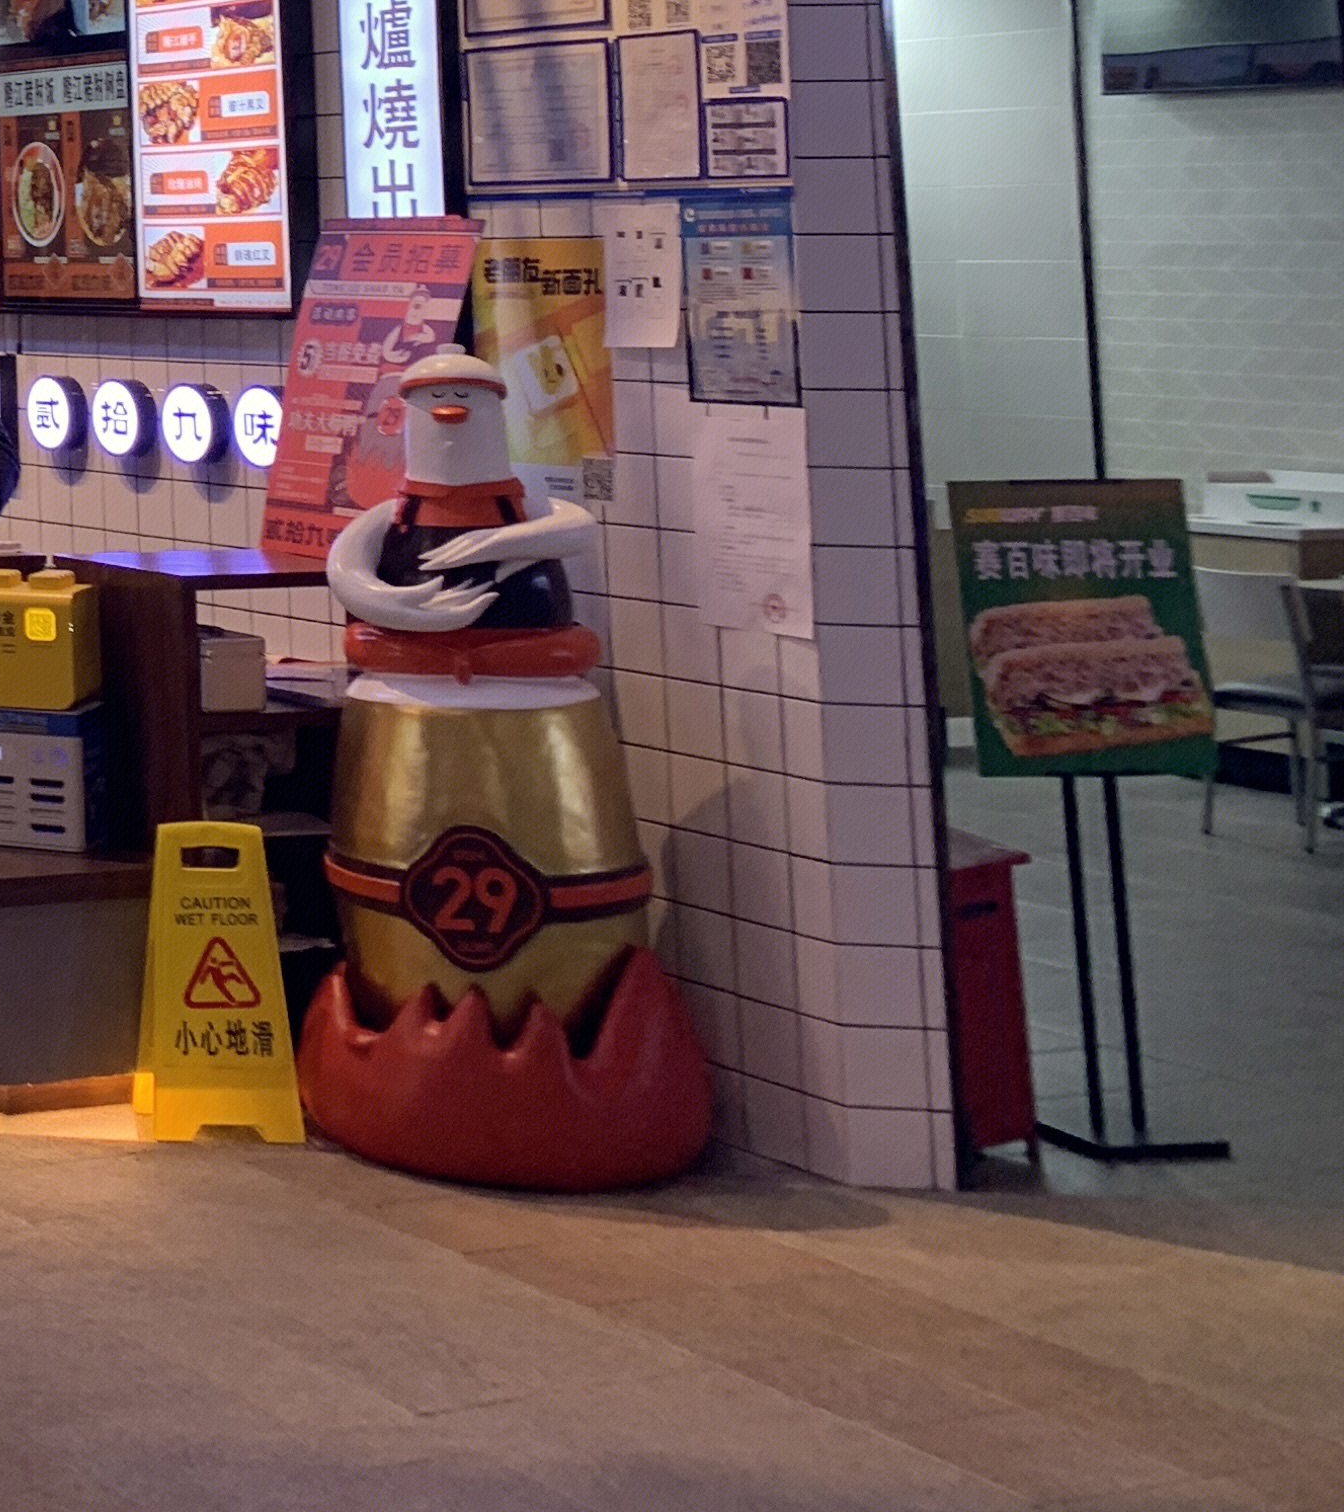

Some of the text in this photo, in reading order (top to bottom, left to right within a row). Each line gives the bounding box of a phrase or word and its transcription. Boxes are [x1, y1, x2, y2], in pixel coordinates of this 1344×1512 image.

[350, 242, 466, 274] 会员招募
[35, 397, 278, 446] 贰拾九味
[180, 896, 252, 911] CAUTION
[432, 865, 518, 933] 29
[174, 913, 259, 926] WET FLOOR
[174, 1018, 275, 1058] 小心地滑
